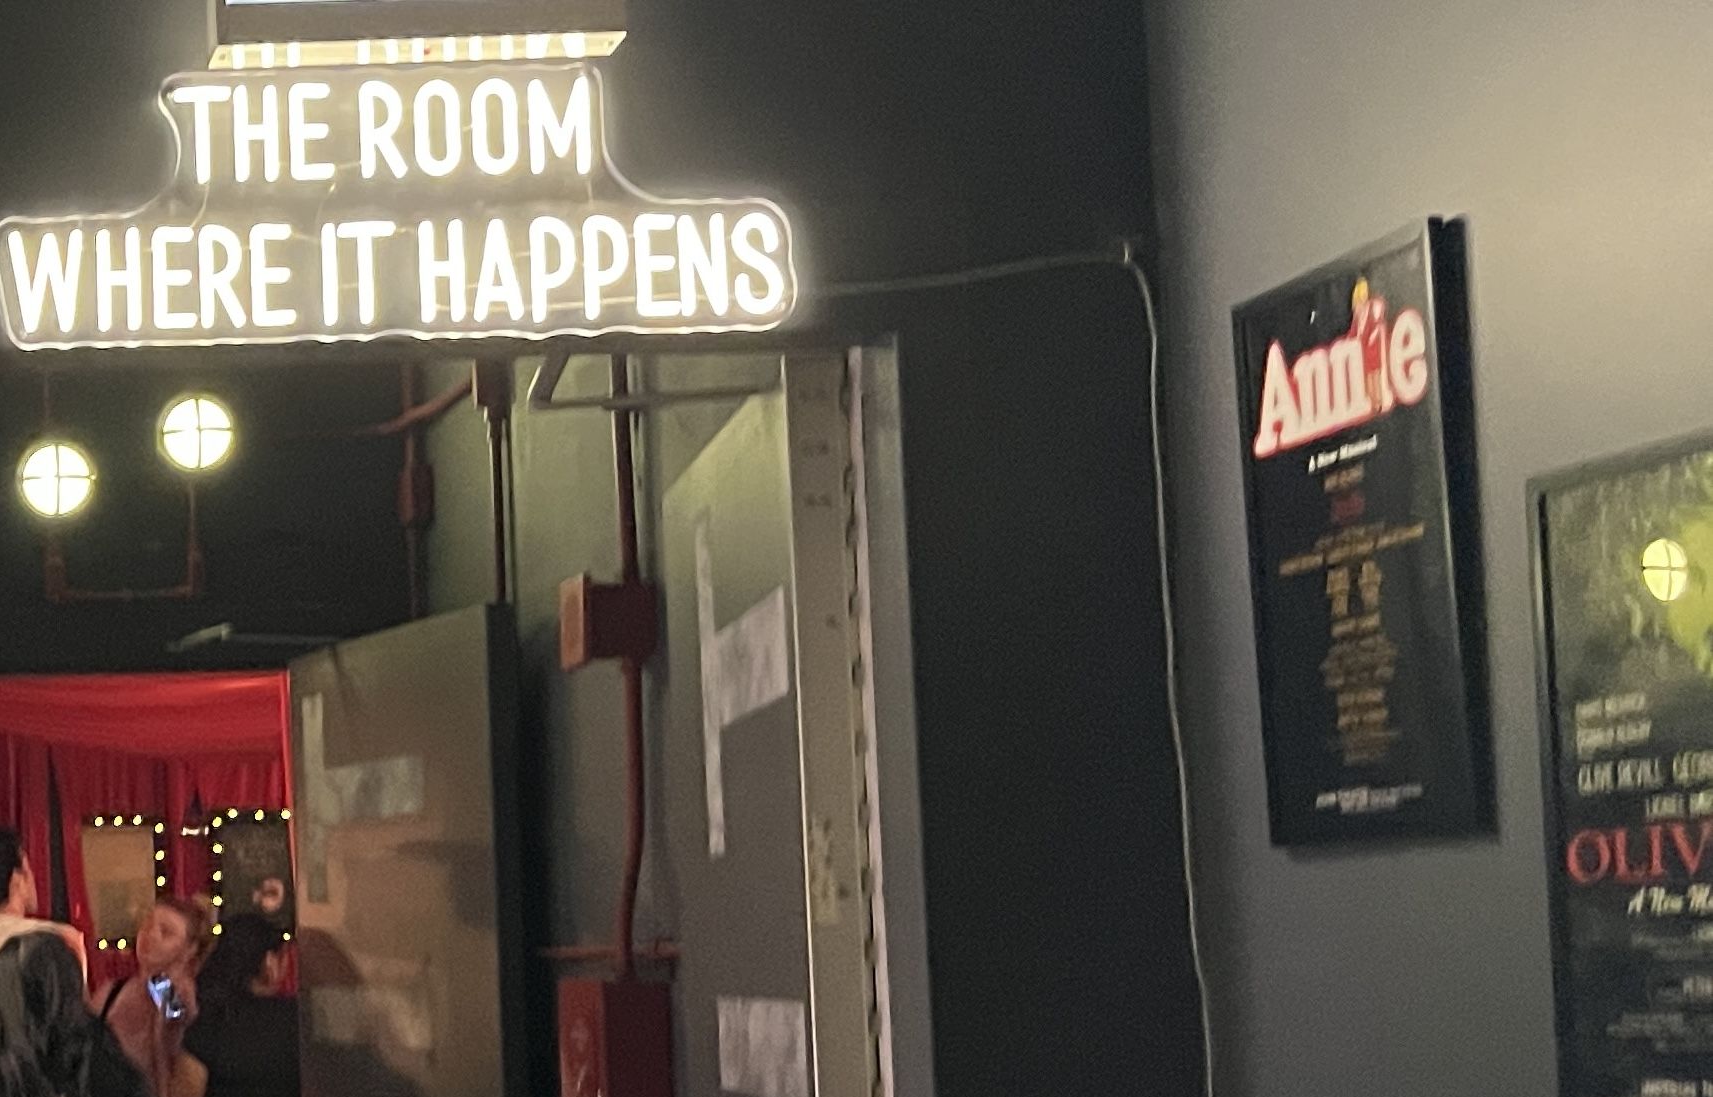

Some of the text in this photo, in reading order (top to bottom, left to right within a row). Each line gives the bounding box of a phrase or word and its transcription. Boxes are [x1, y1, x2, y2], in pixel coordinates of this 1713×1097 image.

[173, 74, 593, 183] THE ROOM
[7, 212, 786, 334] WHERE IT HAPPENS
[1253, 298, 1427, 460] Annie
[1566, 820, 1713, 886] OLIV
